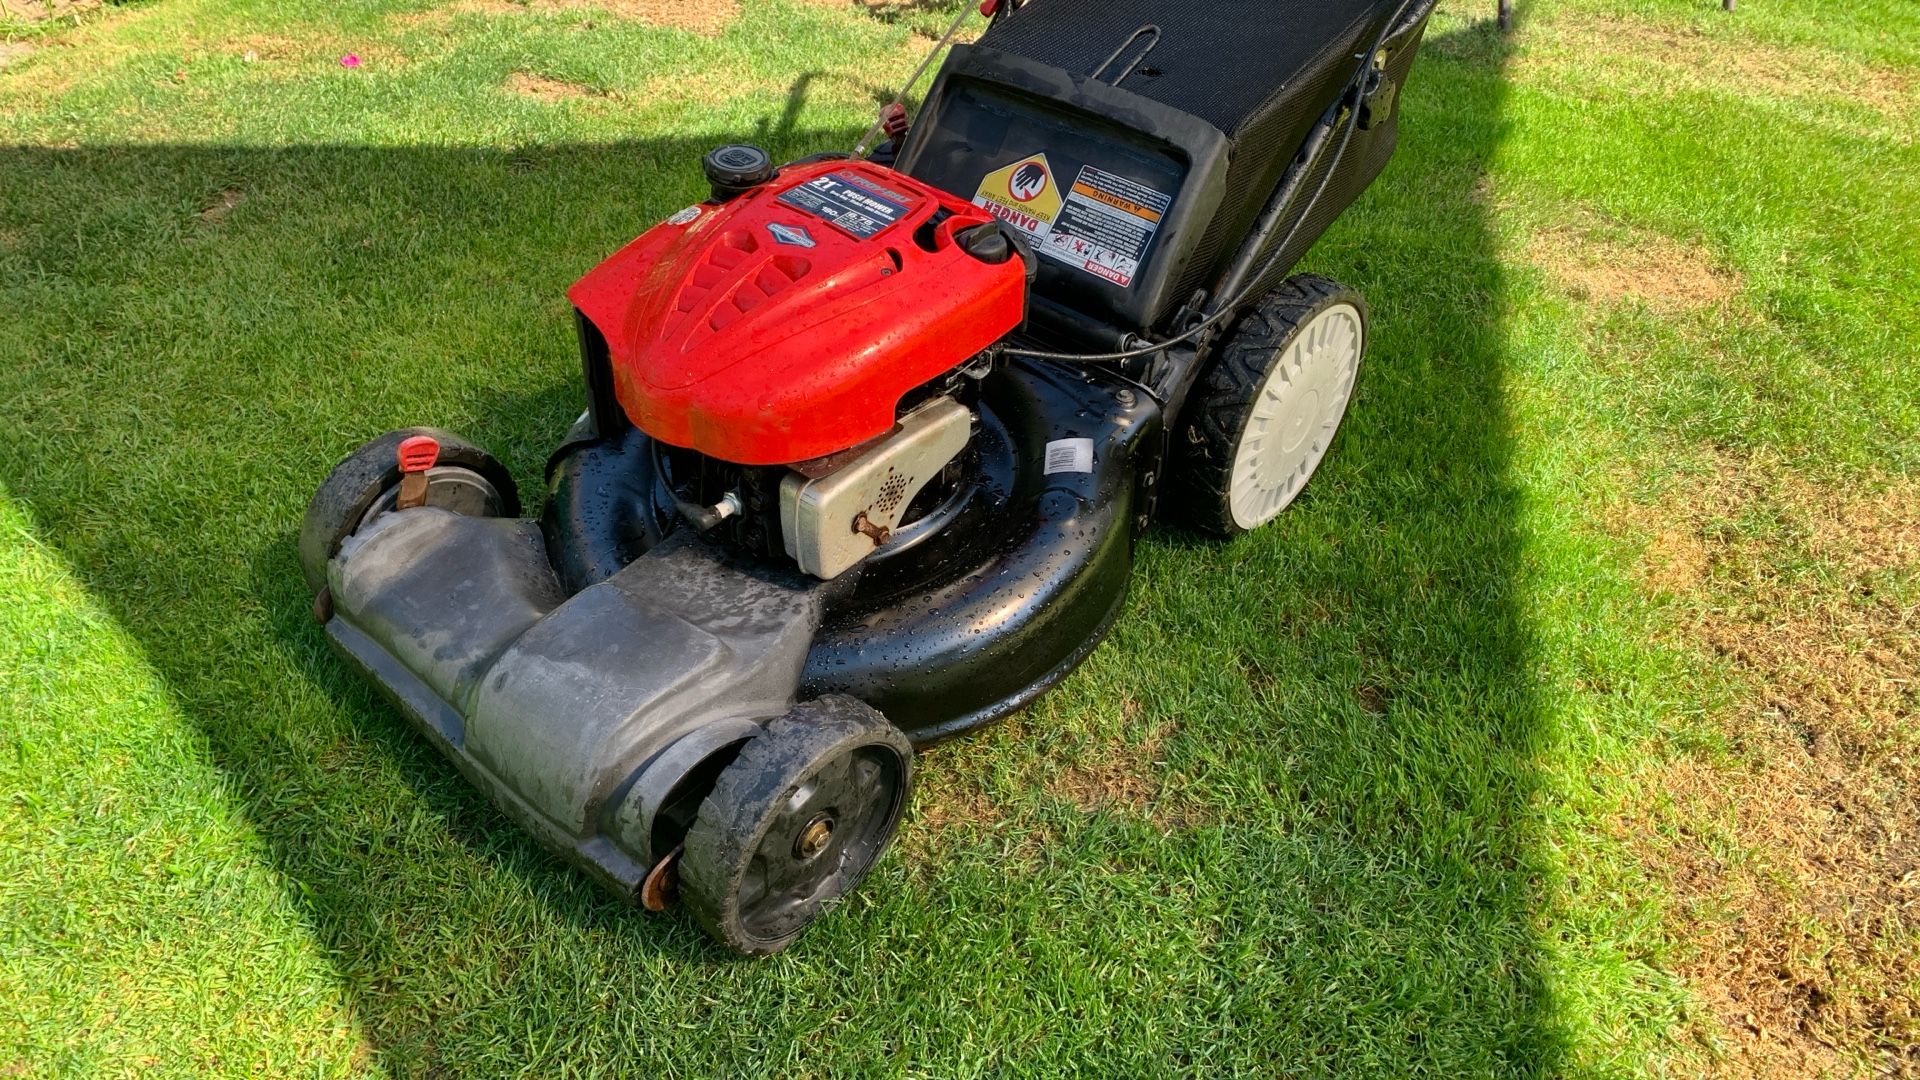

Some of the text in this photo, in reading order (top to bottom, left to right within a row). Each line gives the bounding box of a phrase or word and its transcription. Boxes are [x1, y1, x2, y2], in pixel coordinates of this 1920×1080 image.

[812, 177, 836, 190] 21
[981, 190, 997, 200] AWAY
[995, 196, 1010, 206] FEET
[1093, 191, 1132, 209] WARNING
[842, 190, 894, 214] PUSH MOWER
[1017, 203, 1037, 214] HANDS
[984, 201, 1039, 231] DANGER
[1036, 212, 1051, 222] KEEP
[1087, 262, 1122, 280] DANGER
